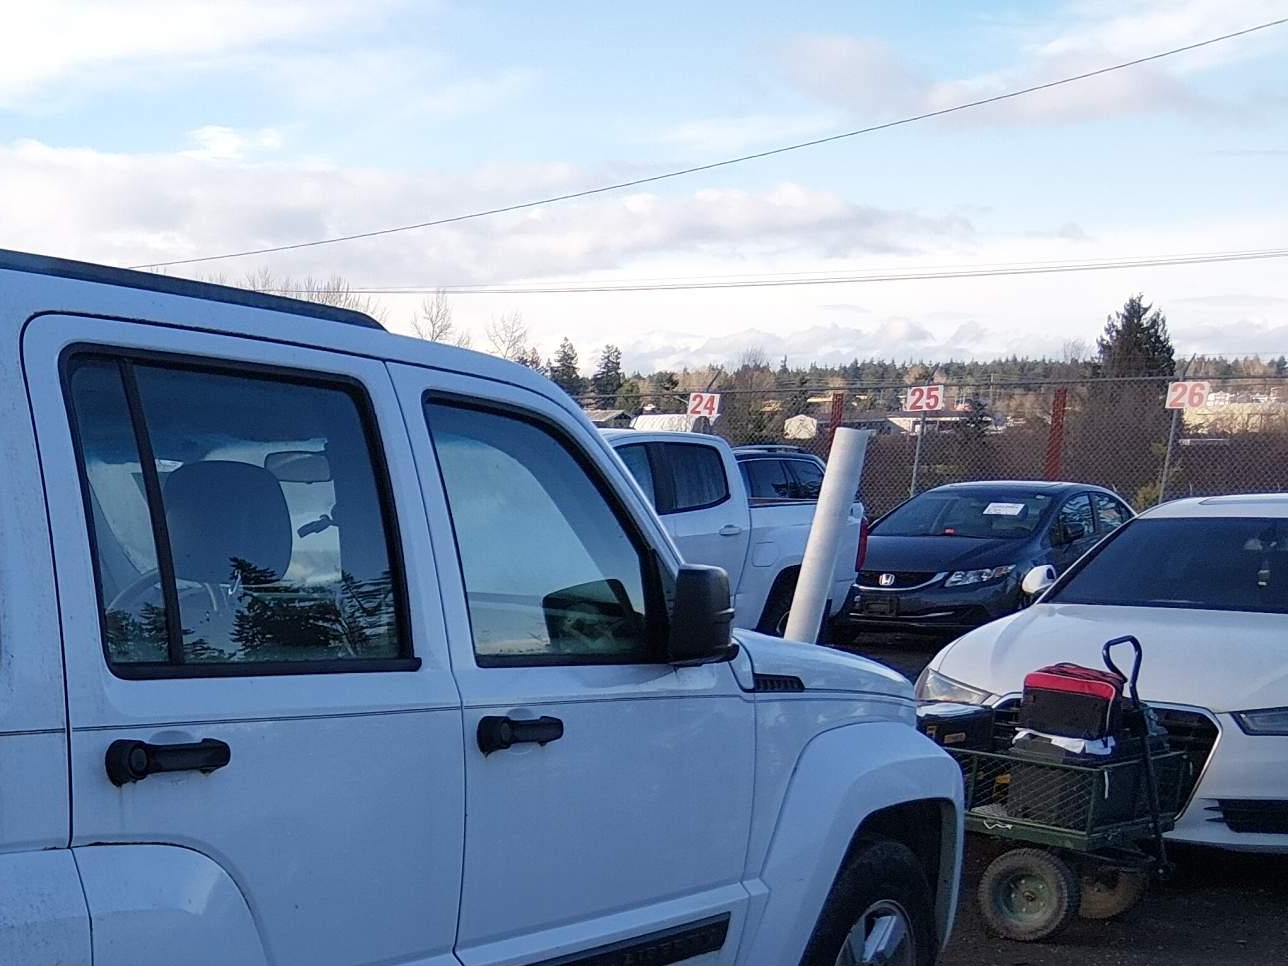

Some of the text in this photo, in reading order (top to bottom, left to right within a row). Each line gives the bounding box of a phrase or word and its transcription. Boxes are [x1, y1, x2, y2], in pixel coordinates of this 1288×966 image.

[690, 394, 716, 416] 24
[910, 387, 940, 410] 25
[1169, 383, 1205, 408] 26
